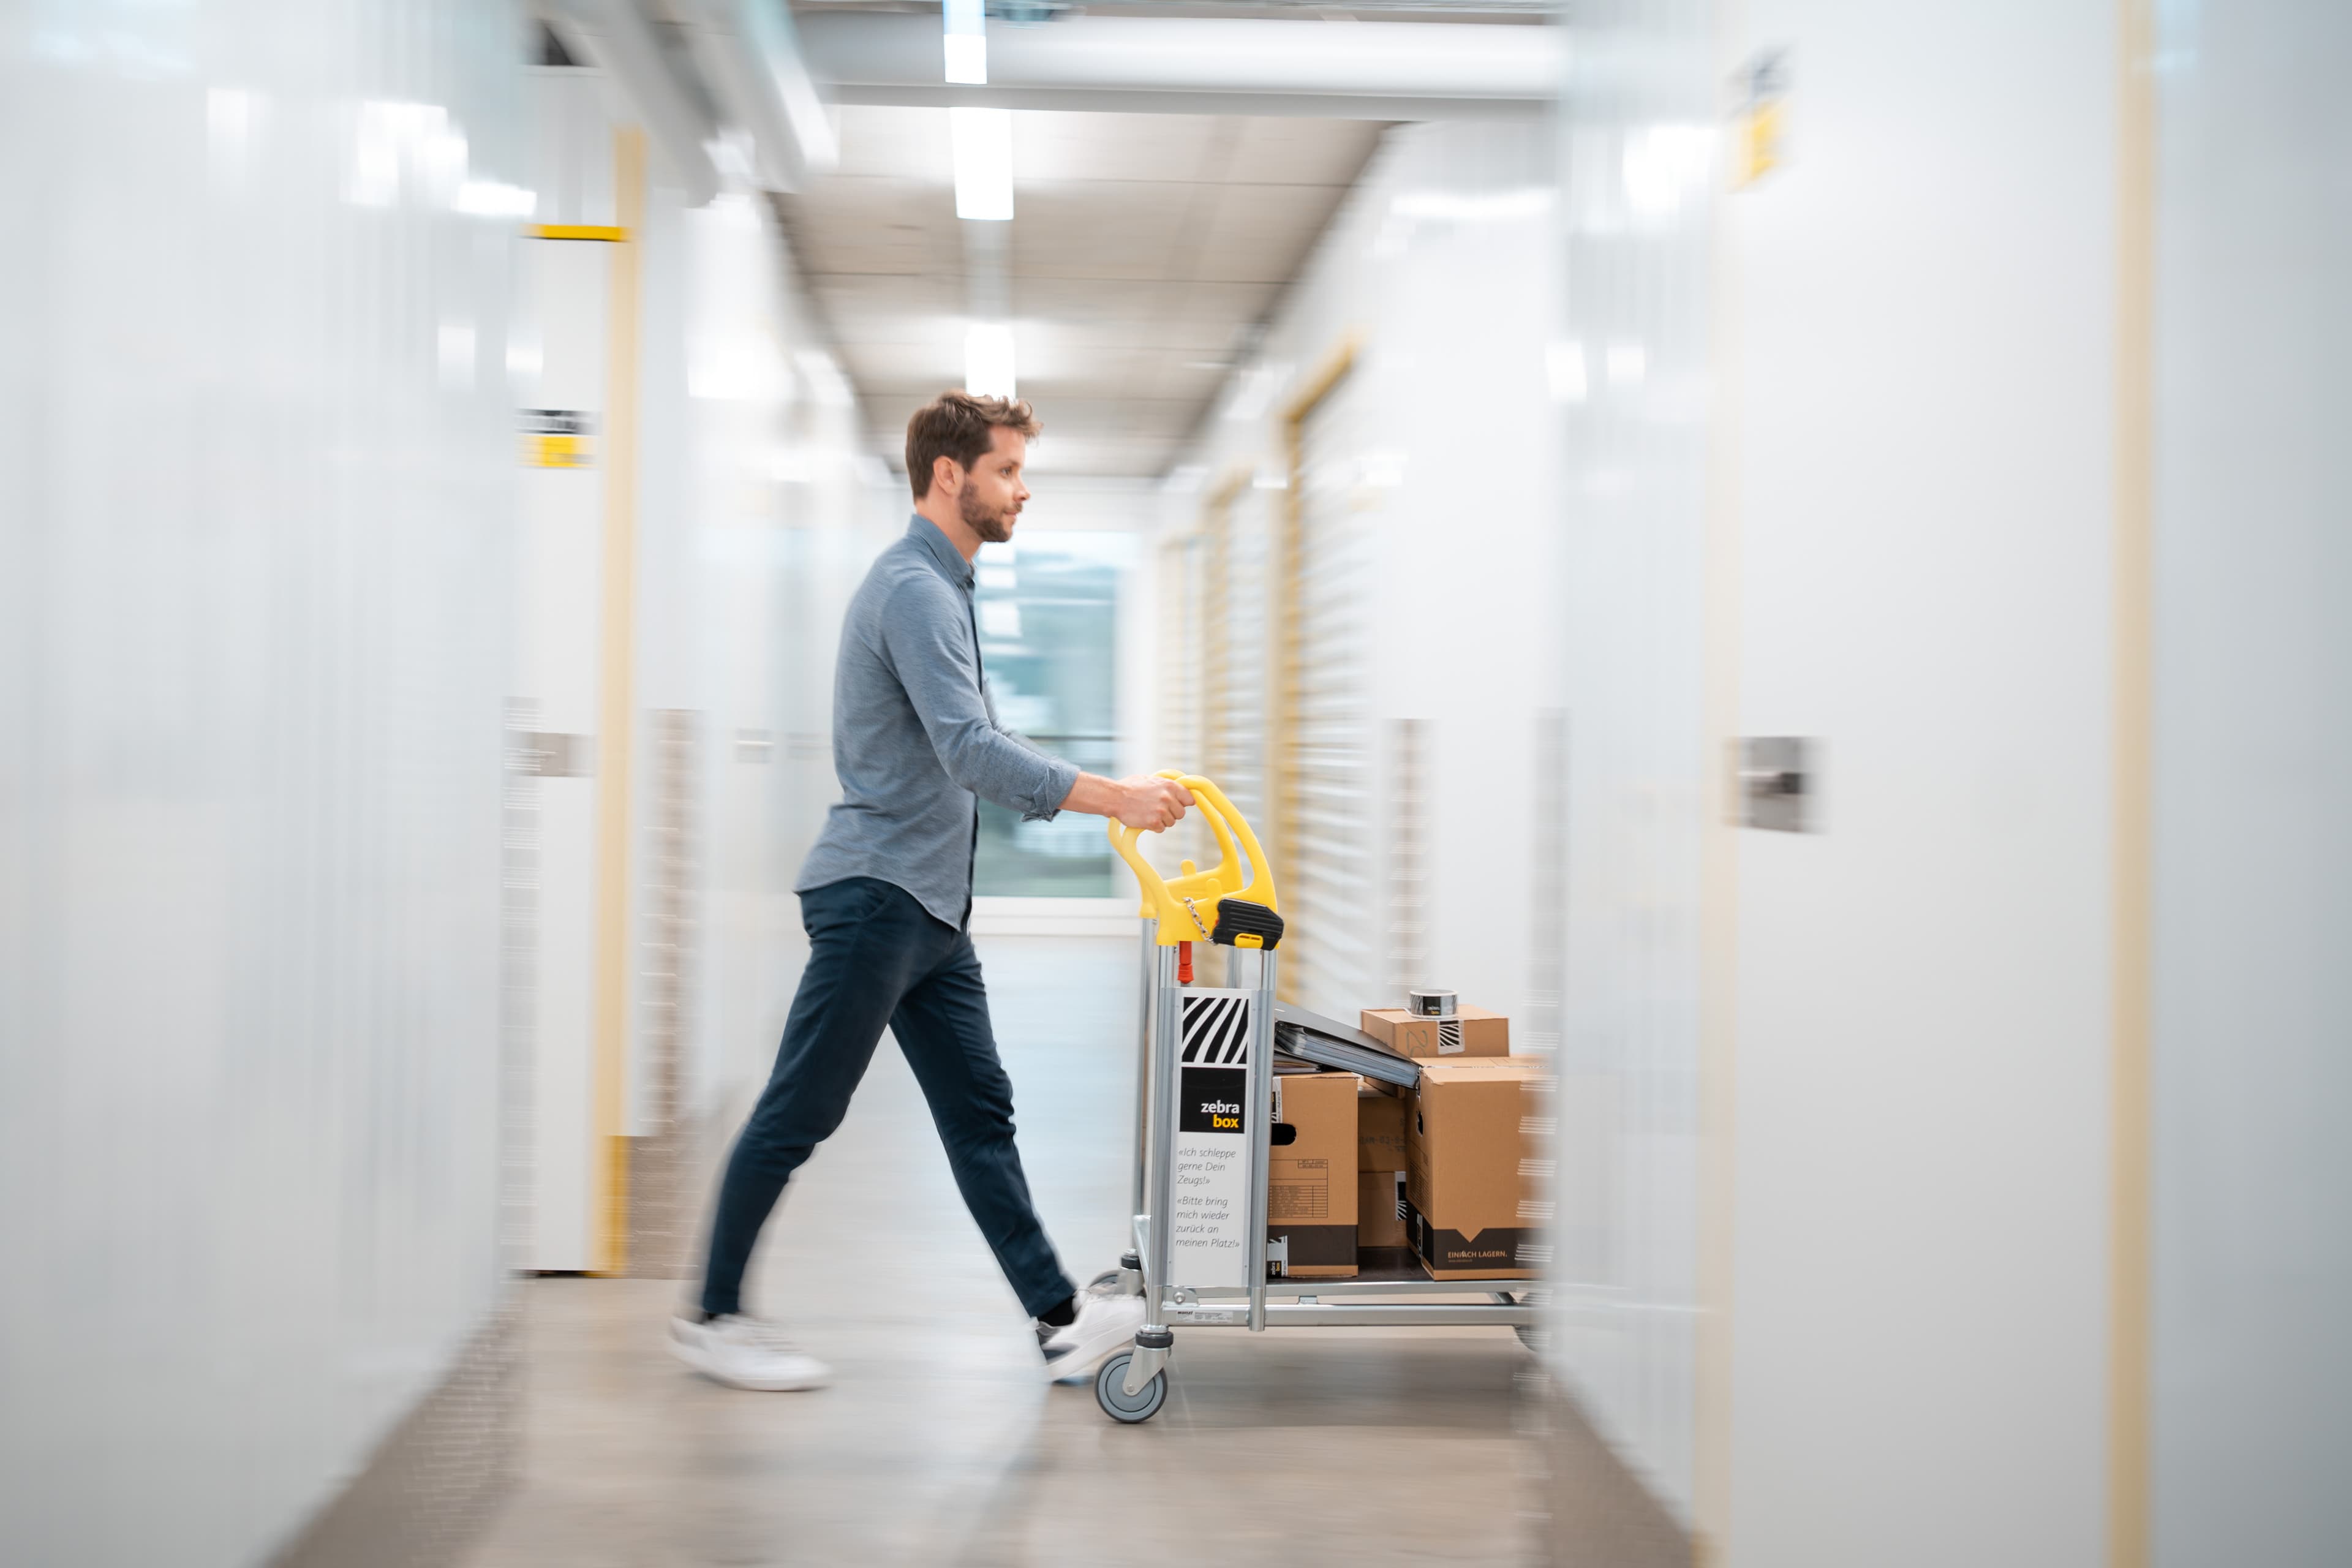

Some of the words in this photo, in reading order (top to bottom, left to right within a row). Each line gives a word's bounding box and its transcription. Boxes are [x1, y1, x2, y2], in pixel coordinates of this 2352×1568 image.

[1200, 1099, 1240, 1114] zebra
[1213, 1114, 1239, 1128] box
[1179, 1147, 1197, 1157] «Ich
[1199, 1148, 1236, 1160] schleppe
[1178, 1163, 1202, 1172] gerne
[1205, 1162, 1226, 1171] Dein
[1177, 1175, 1210, 1187] Zeugs!»
[1177, 1196, 1203, 1205] «Bitte
[1205, 1196, 1228, 1209] bring
[1177, 1210, 1198, 1219] mich
[1201, 1210, 1230, 1220] wieder
[1175, 1224, 1205, 1233] zurück
[1176, 1238, 1208, 1247] meinen
[1211, 1238, 1240, 1248] Platz!»
